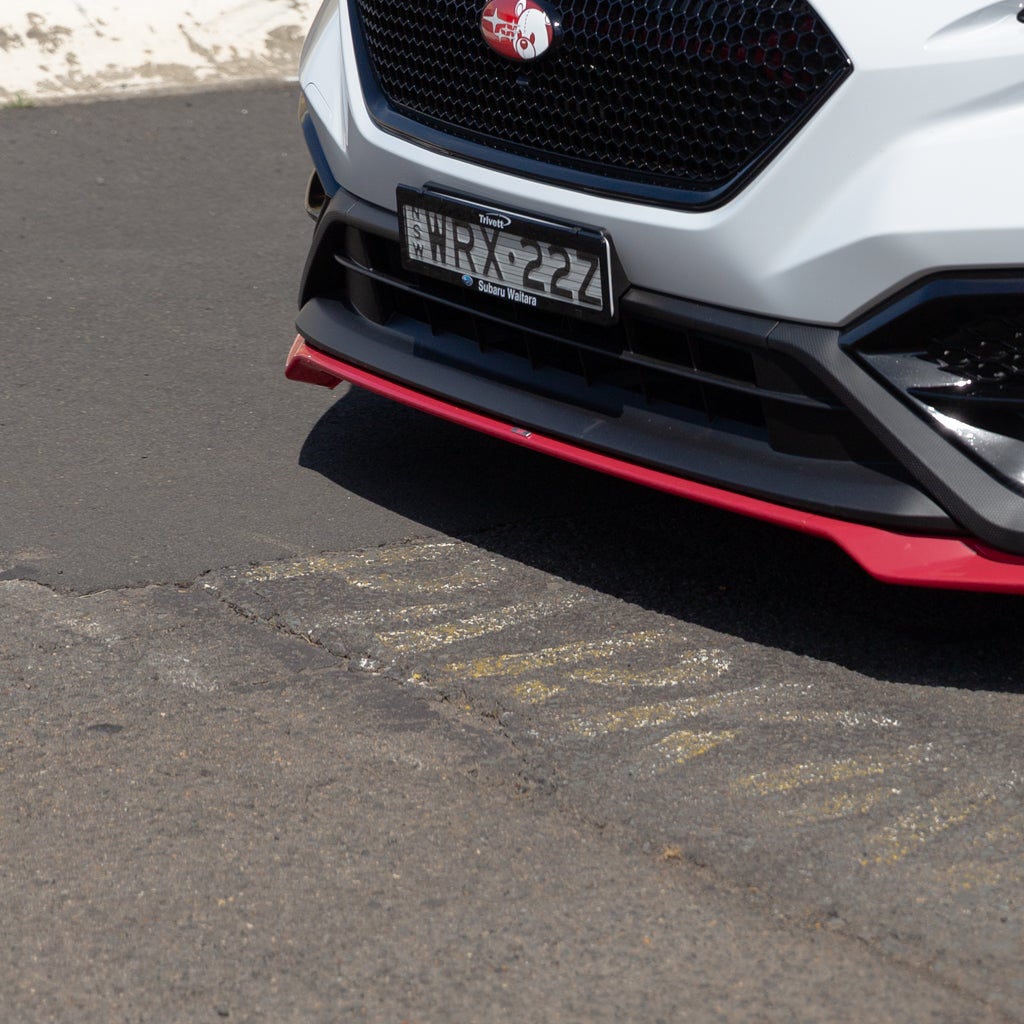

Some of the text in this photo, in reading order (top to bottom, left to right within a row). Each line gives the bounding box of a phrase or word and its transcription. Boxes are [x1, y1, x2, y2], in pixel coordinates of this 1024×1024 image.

[478, 213, 505, 229] Trivett
[478, 280, 537, 307] Subaru Waitara
